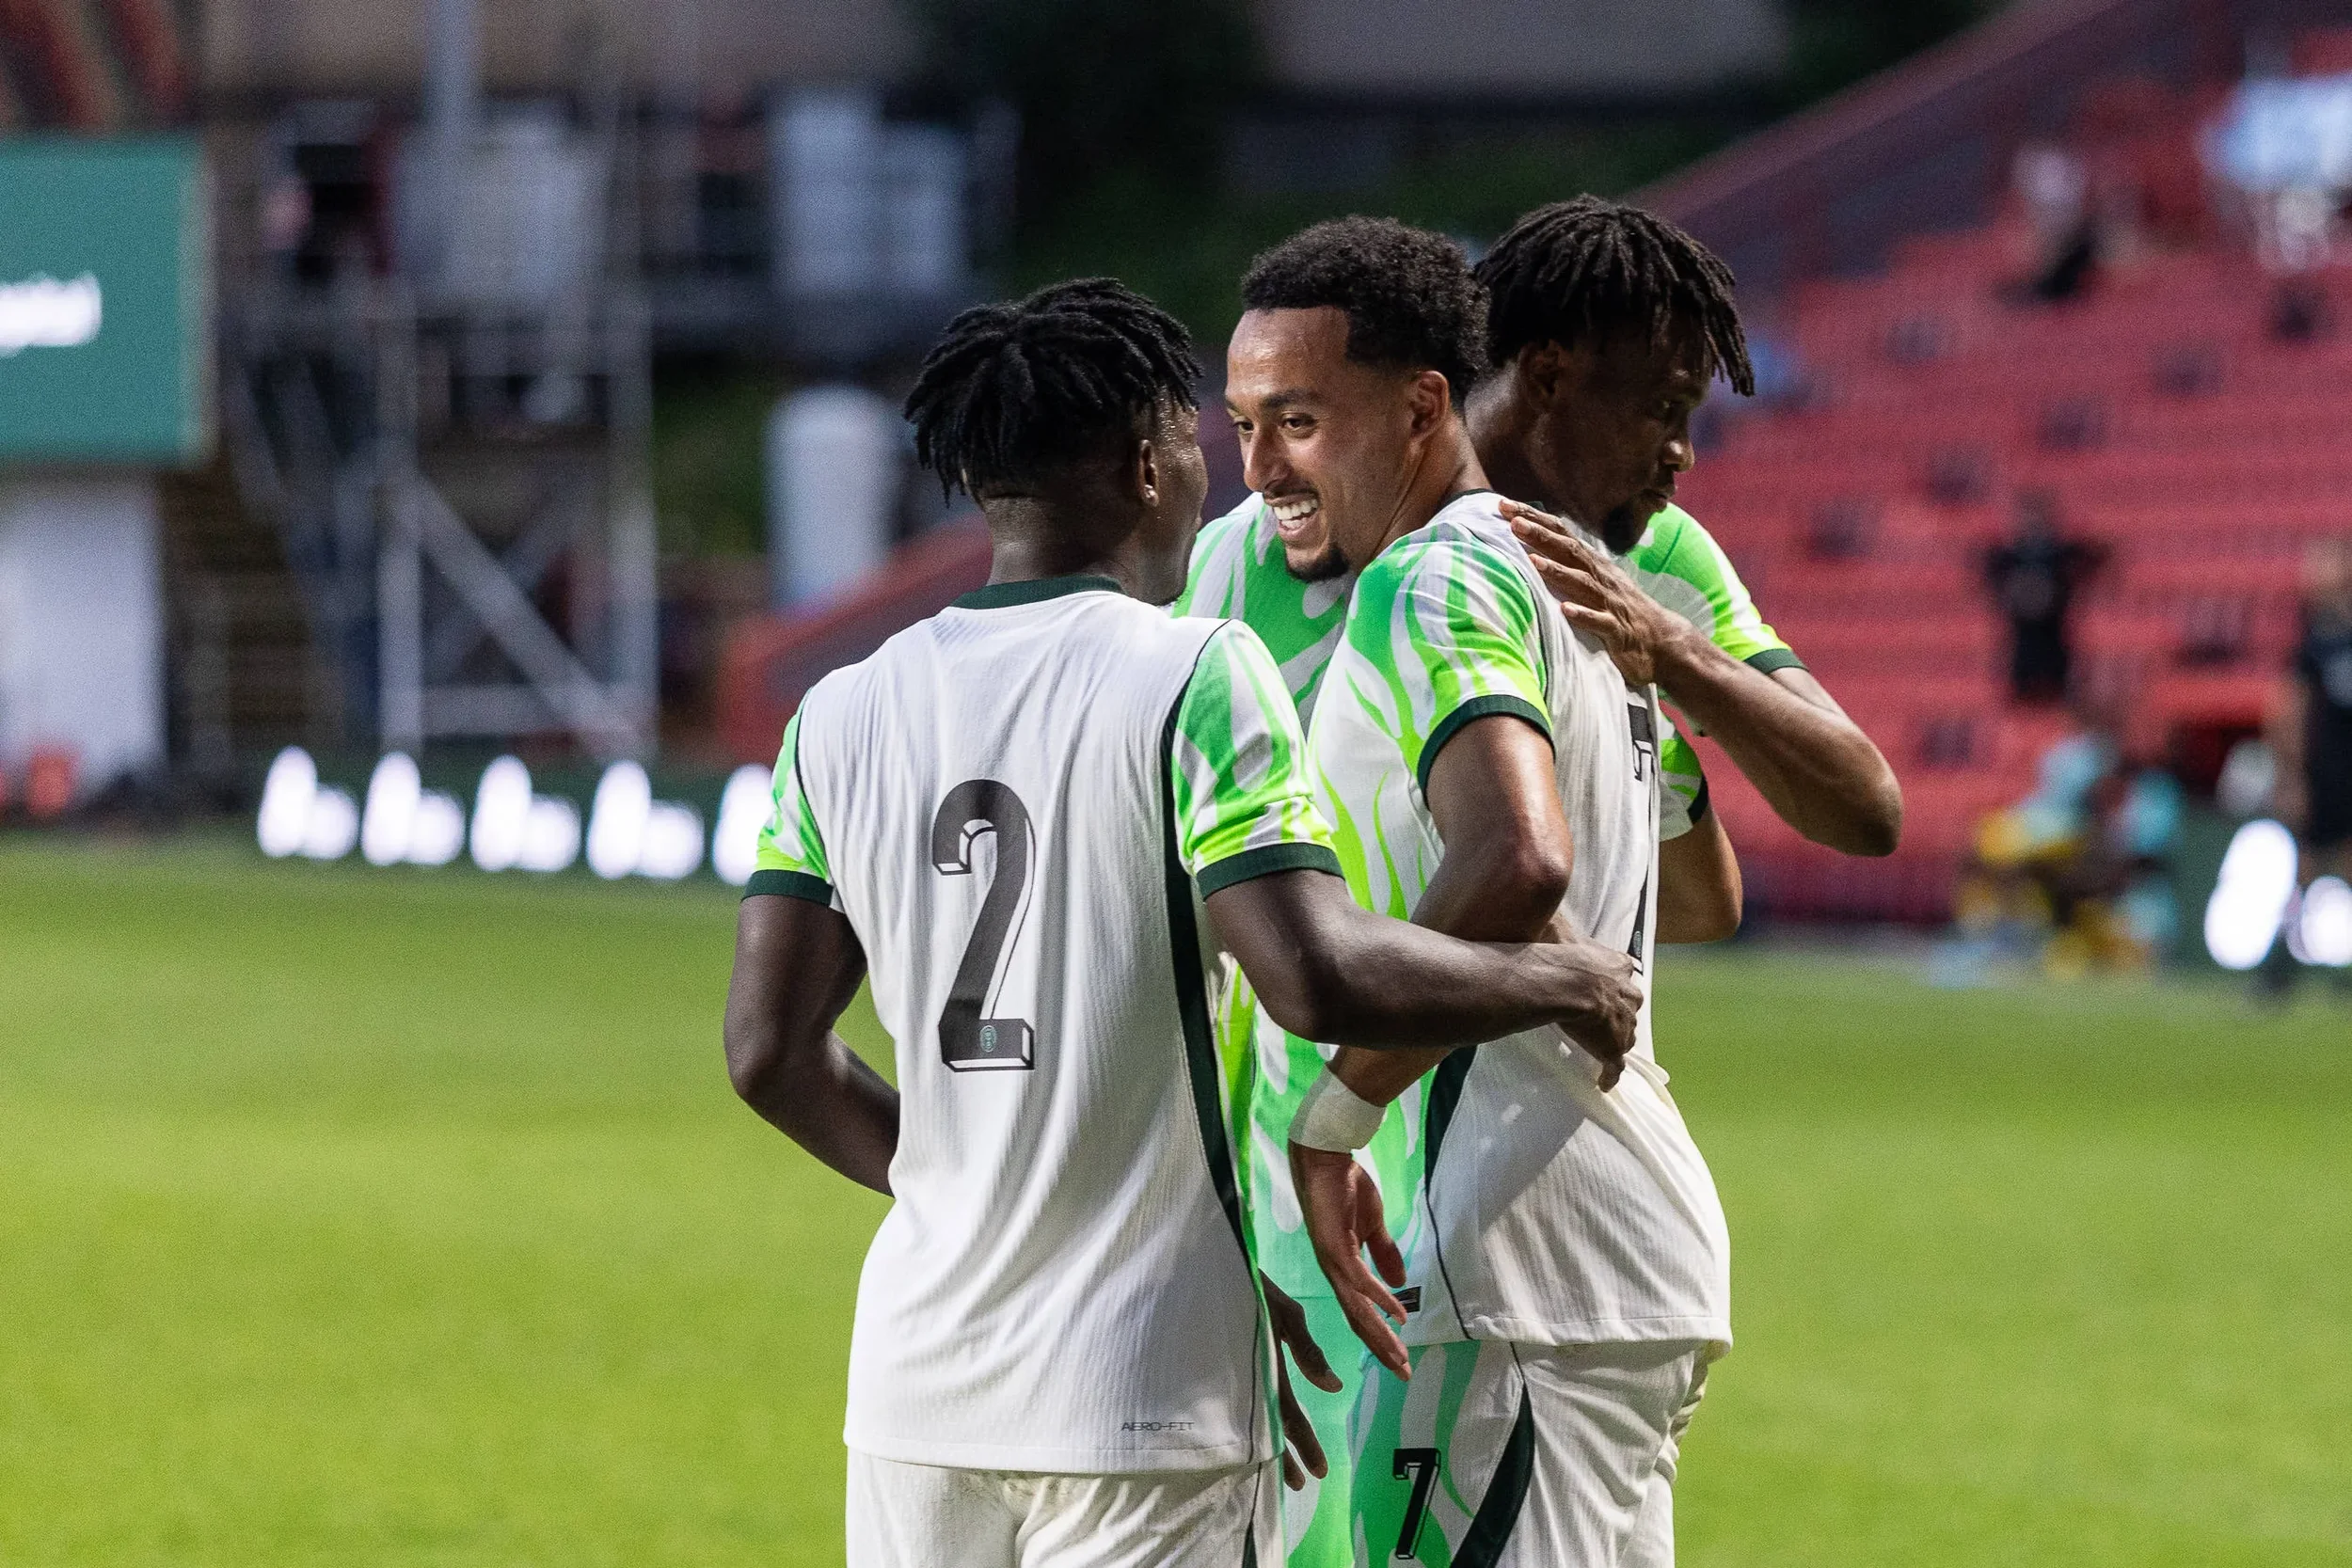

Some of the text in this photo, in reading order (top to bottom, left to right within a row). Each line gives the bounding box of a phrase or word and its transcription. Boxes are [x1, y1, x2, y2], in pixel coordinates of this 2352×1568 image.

[932, 779, 1035, 1072] 2
[1120, 1421, 1195, 1432] AERO-FIT
[1392, 1448, 1441, 1560] 7
